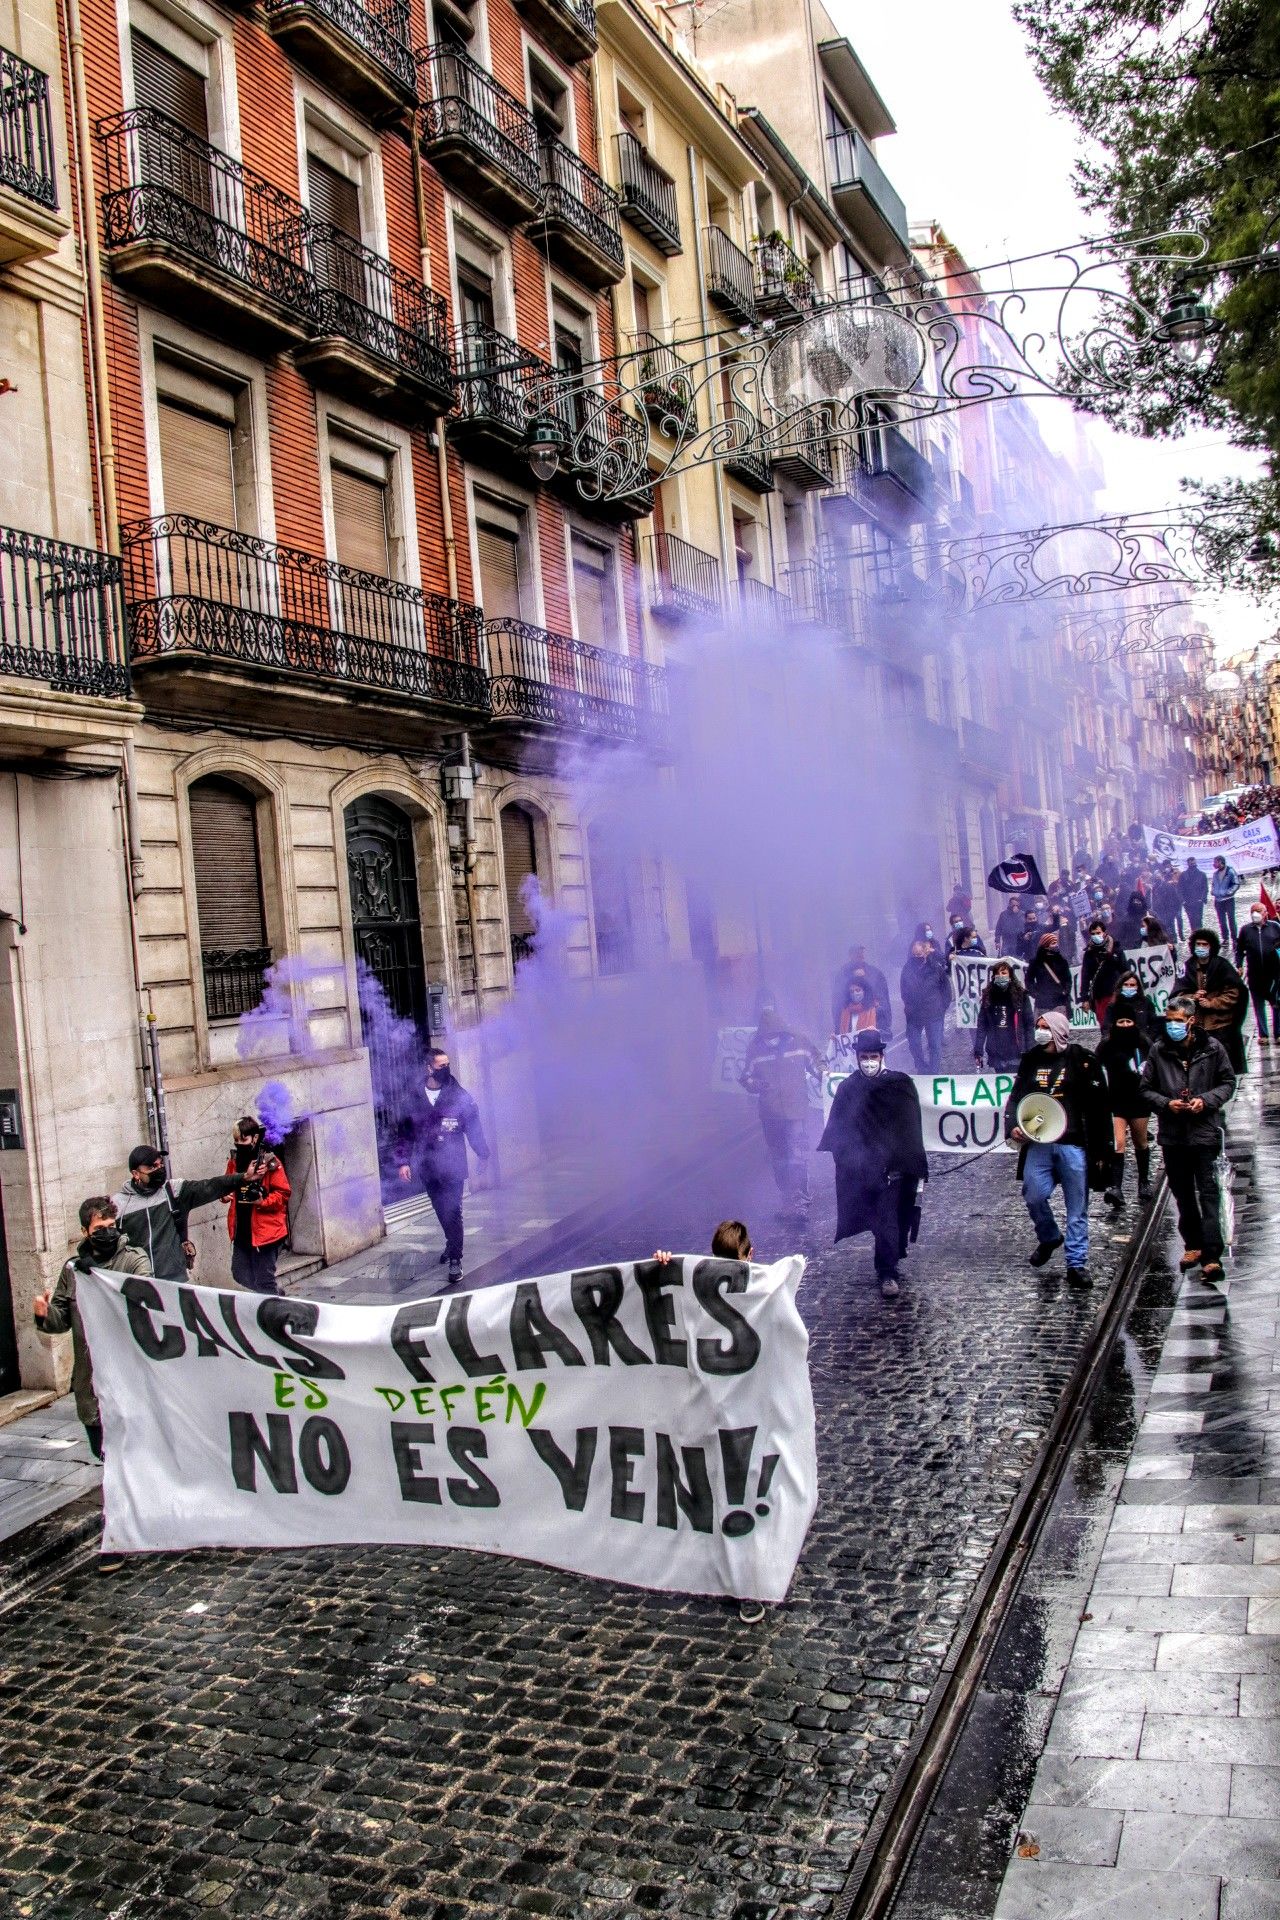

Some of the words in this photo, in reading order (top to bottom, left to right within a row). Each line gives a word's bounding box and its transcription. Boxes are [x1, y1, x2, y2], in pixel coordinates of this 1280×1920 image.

[1243, 828, 1261, 838] CALS
[121, 1277, 346, 1380] CALS
[391, 1257, 761, 1383] FLARES
[274, 1372, 329, 1410] ES
[375, 1375, 547, 1428] DEFÉN
[228, 1411, 351, 1496] NO
[391, 1421, 501, 1507] ES
[526, 1425, 780, 1537] VEN!!
